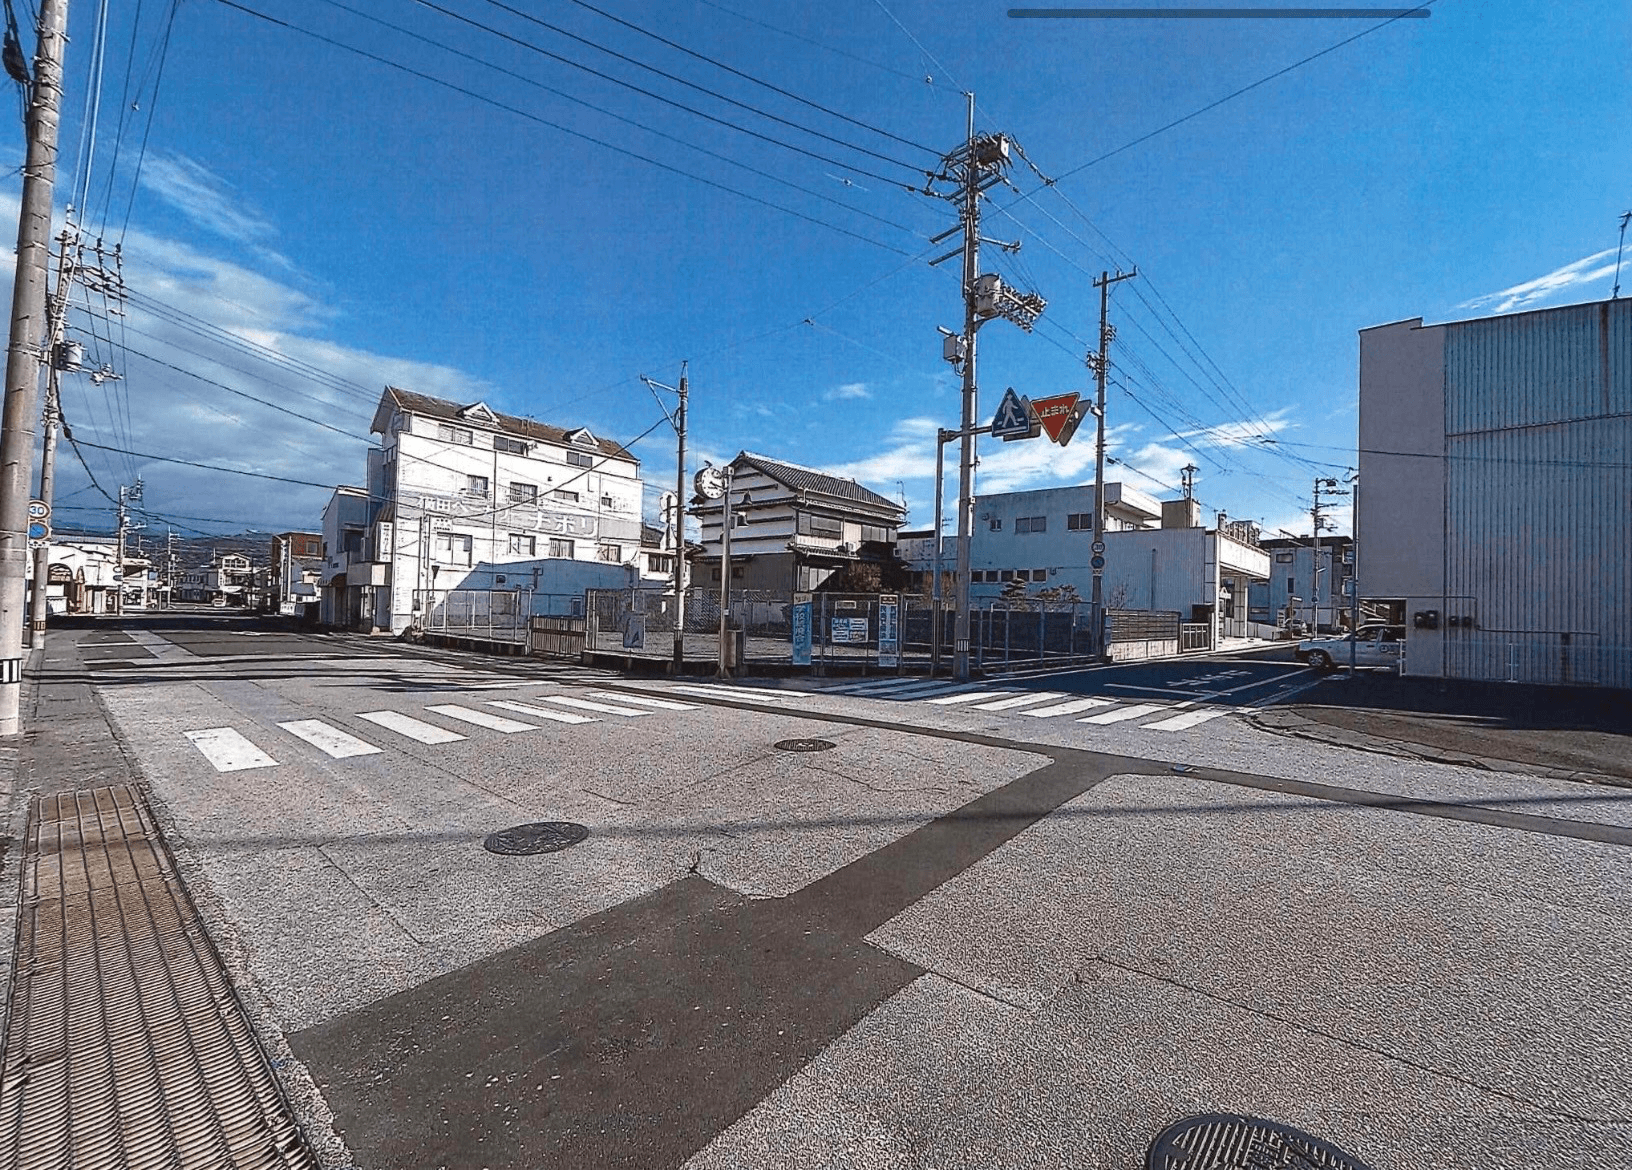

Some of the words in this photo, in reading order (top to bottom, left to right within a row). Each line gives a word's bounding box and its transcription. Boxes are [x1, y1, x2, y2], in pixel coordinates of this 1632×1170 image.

[1041, 404, 1070, 418] 止まれ
[29, 506, 44, 515] 30
